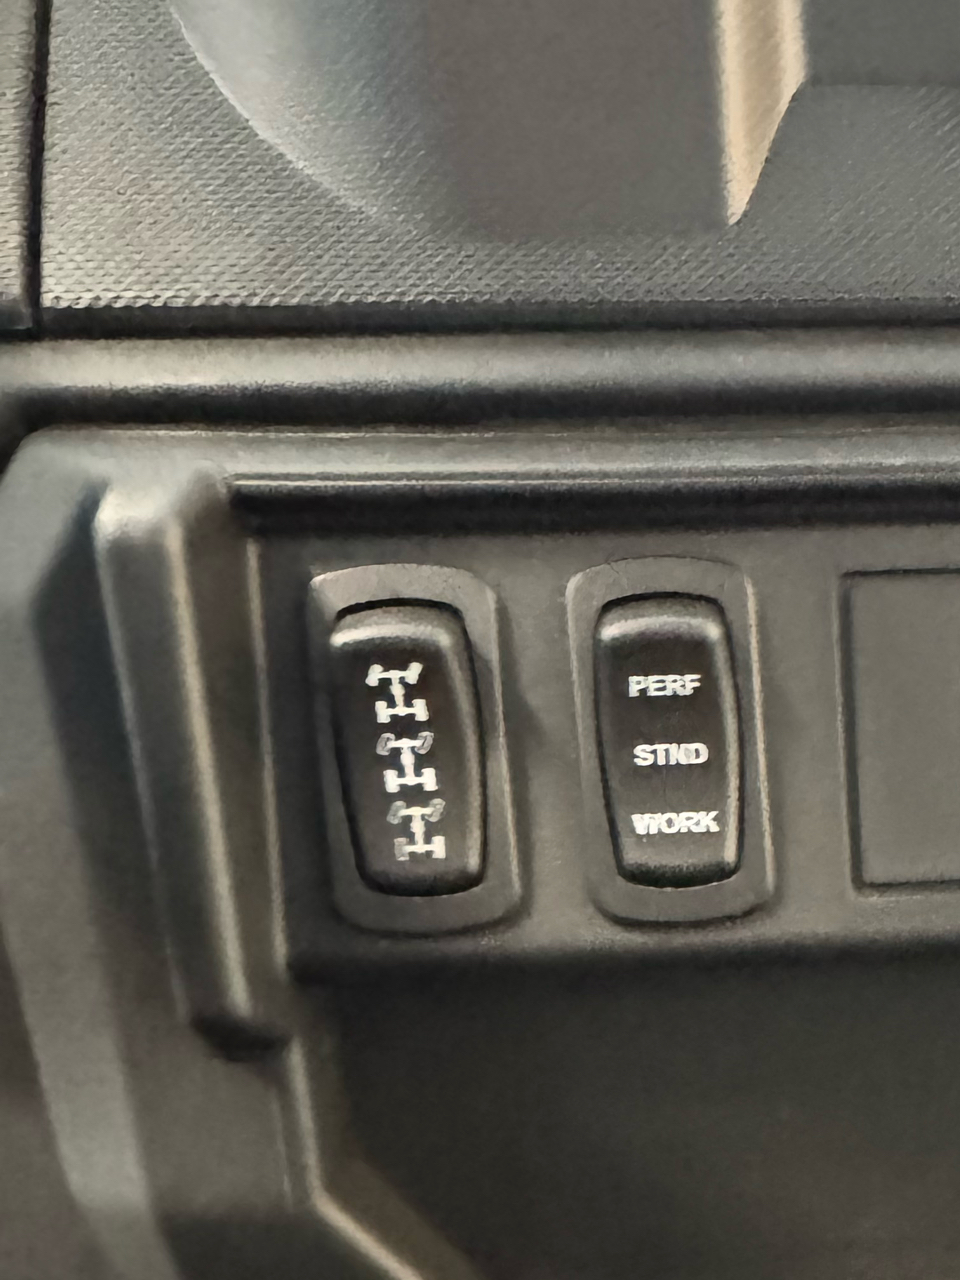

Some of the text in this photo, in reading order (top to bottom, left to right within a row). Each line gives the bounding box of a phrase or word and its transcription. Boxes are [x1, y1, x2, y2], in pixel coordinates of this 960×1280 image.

[628, 674, 702, 697] PERF
[633, 743, 709, 766] STND
[631, 811, 720, 834] WORK
